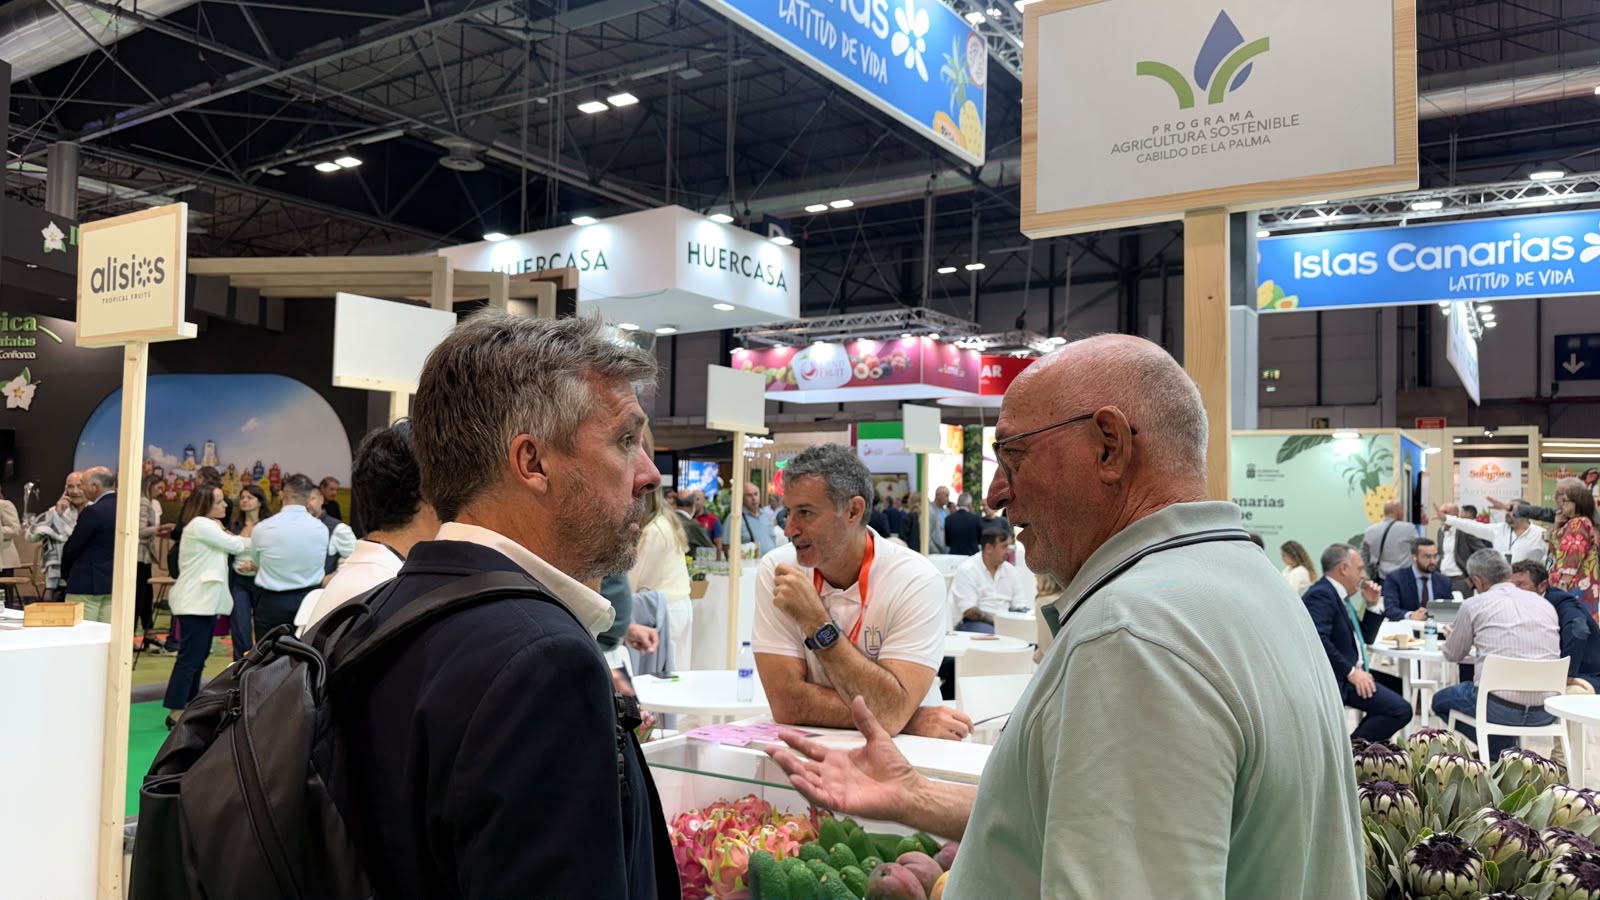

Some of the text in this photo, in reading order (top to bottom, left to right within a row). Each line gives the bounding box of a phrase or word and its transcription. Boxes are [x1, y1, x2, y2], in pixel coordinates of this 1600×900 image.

[829, 0, 890, 39] as
[842, 31, 858, 65] DE
[861, 43, 888, 85] VIDA
[1110, 114, 1300, 155] AGRICULTURA SOSTENIBLE
[1152, 110, 1254, 134] PROGRAMA
[1136, 135, 1271, 163] CABILDO DE LA PALMA
[491, 249, 609, 276] ERCASA
[687, 241, 788, 293] HUERCASA
[1294, 232, 1576, 280] Islas Canarias
[90, 253, 166, 294] alisios
[1516, 271, 1535, 288] DE
[1538, 267, 1575, 287] VIDA
[102, 291, 151, 304] TROPICAL FRUITS
[0, 312, 37, 331] ica
